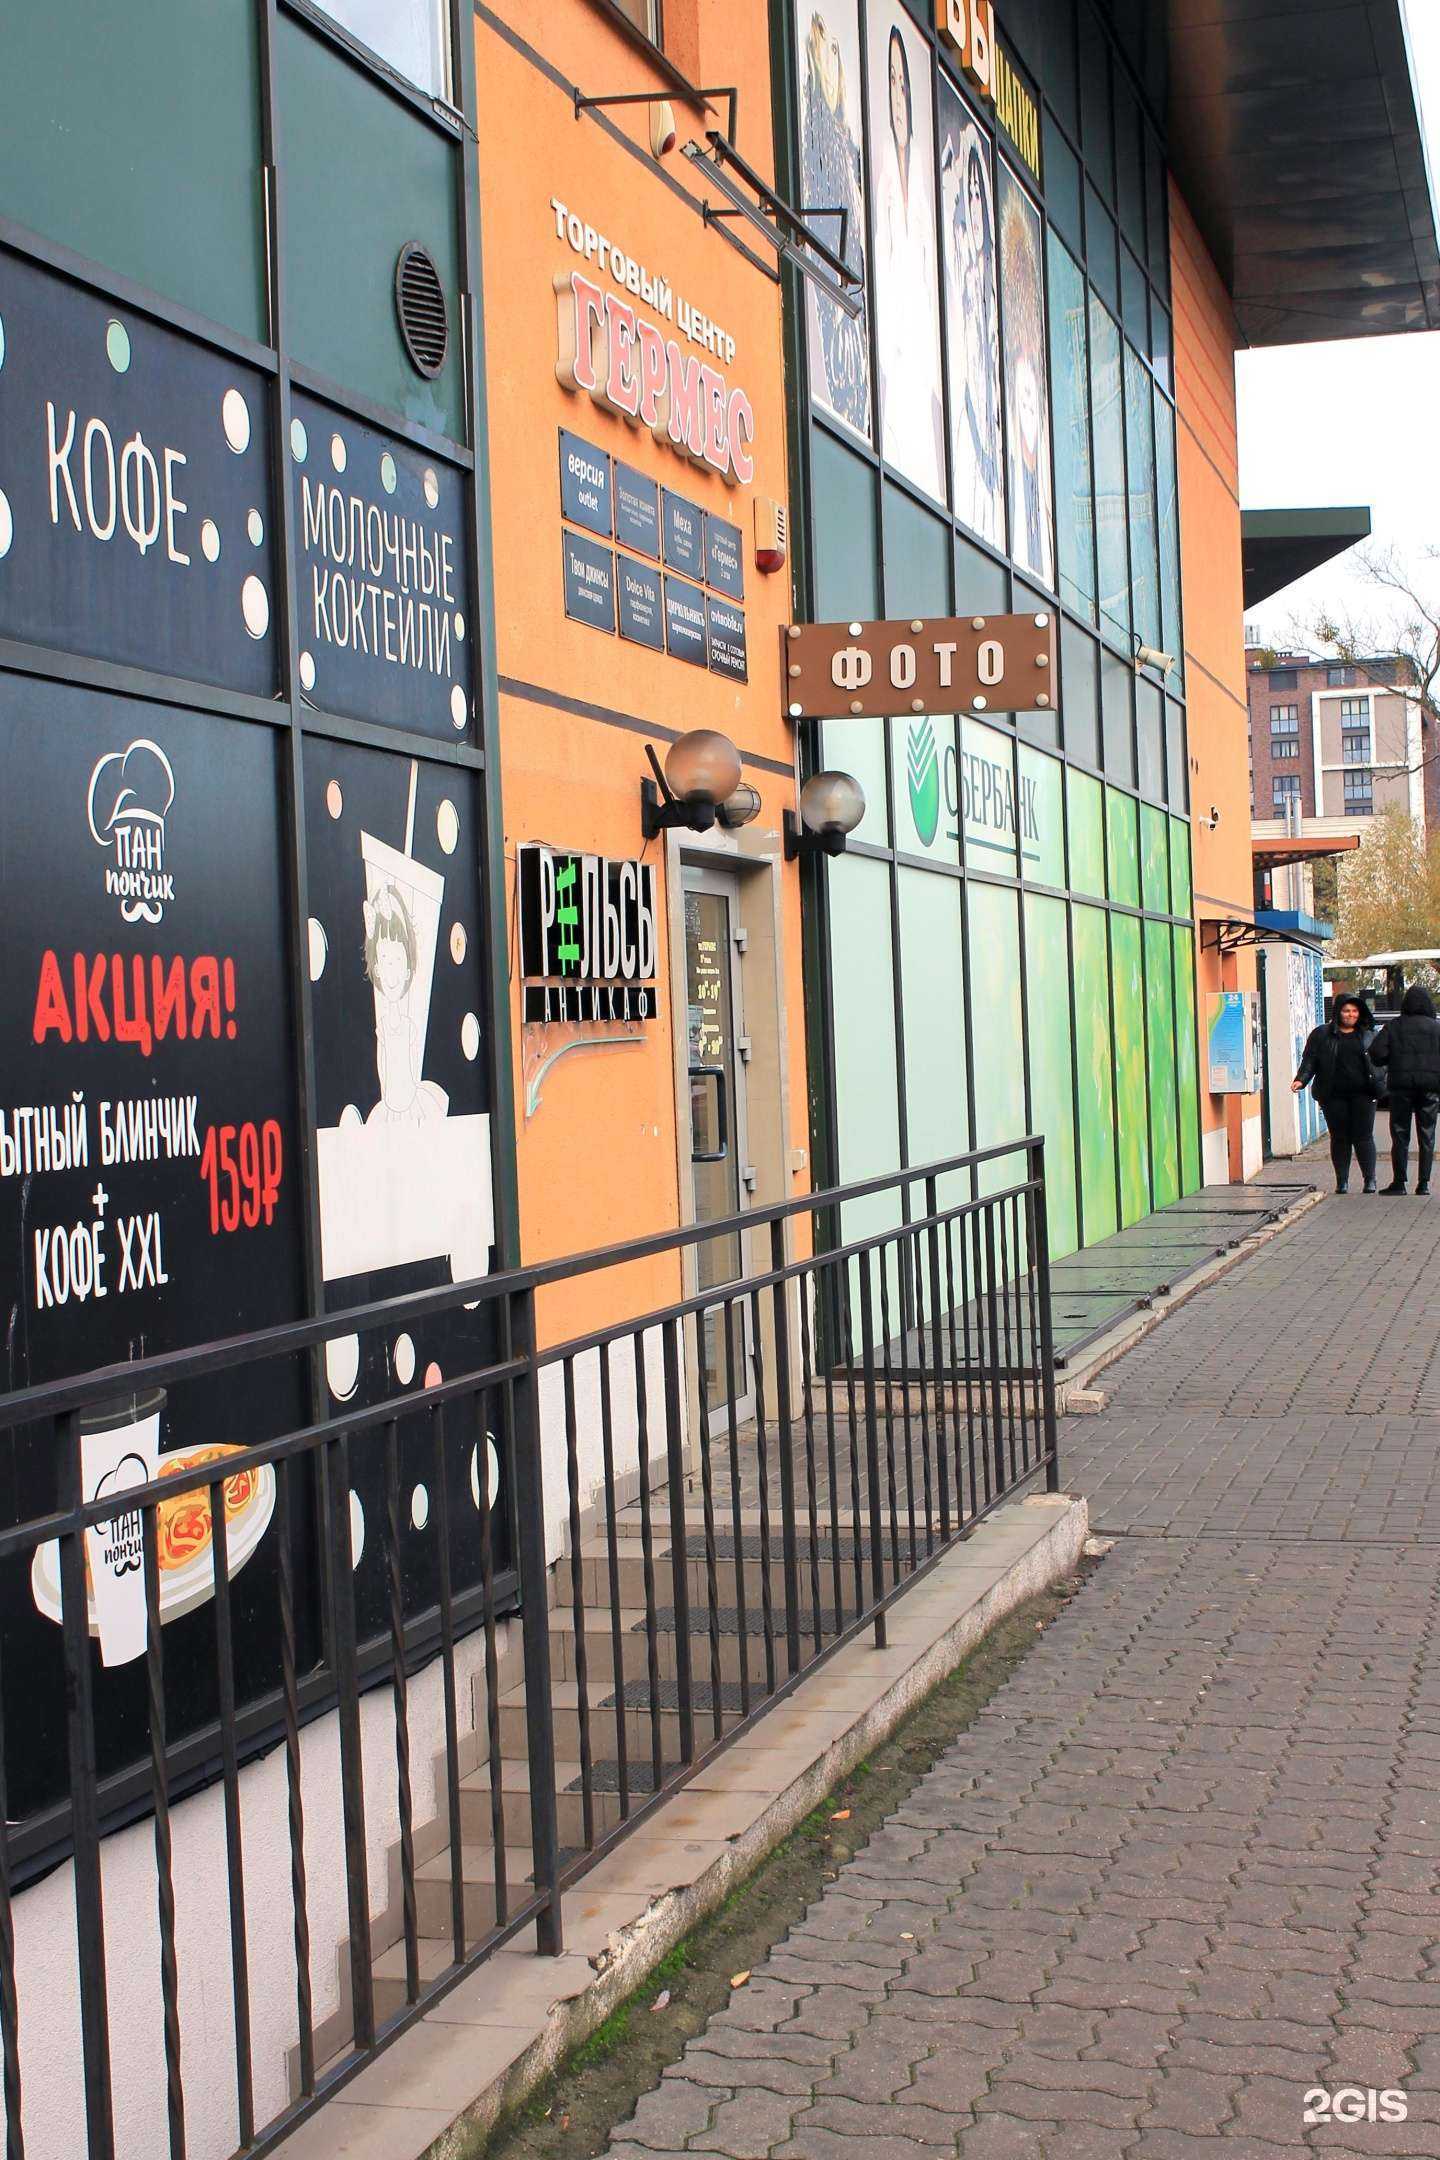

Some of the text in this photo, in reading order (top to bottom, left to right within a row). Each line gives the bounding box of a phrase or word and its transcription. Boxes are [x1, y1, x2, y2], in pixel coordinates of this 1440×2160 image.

[550, 197, 736, 365] ТОРГОВЫЙ ЦЕНТР
[570, 271, 755, 485] ГЕРМЕС
[46, 401, 191, 566] КОФЕ
[568, 453, 605, 490] версия
[578, 491, 599, 512] outlet
[673, 509, 692, 535] Меха
[302, 475, 455, 604] МОЛОЧНЫЕ
[585, 564, 609, 589] джинсы
[625, 576, 656, 602] Dolce Vita
[313, 563, 451, 678] КОКТЕЙЛИ
[831, 640, 1004, 690] ФОТО
[944, 745, 1040, 842] СБЕРБАНК
[114, 825, 162, 871] ПАН
[105, 869, 175, 900] пончик
[33, 949, 238, 1056] АКЦИЯ!
[100, 1096, 201, 1165] БЛИНЧИК
[34, 1212, 168, 1309] КОФЕ XXL
[111, 1509, 140, 1543] ПАН
[104, 1539, 142, 1564] пончи
